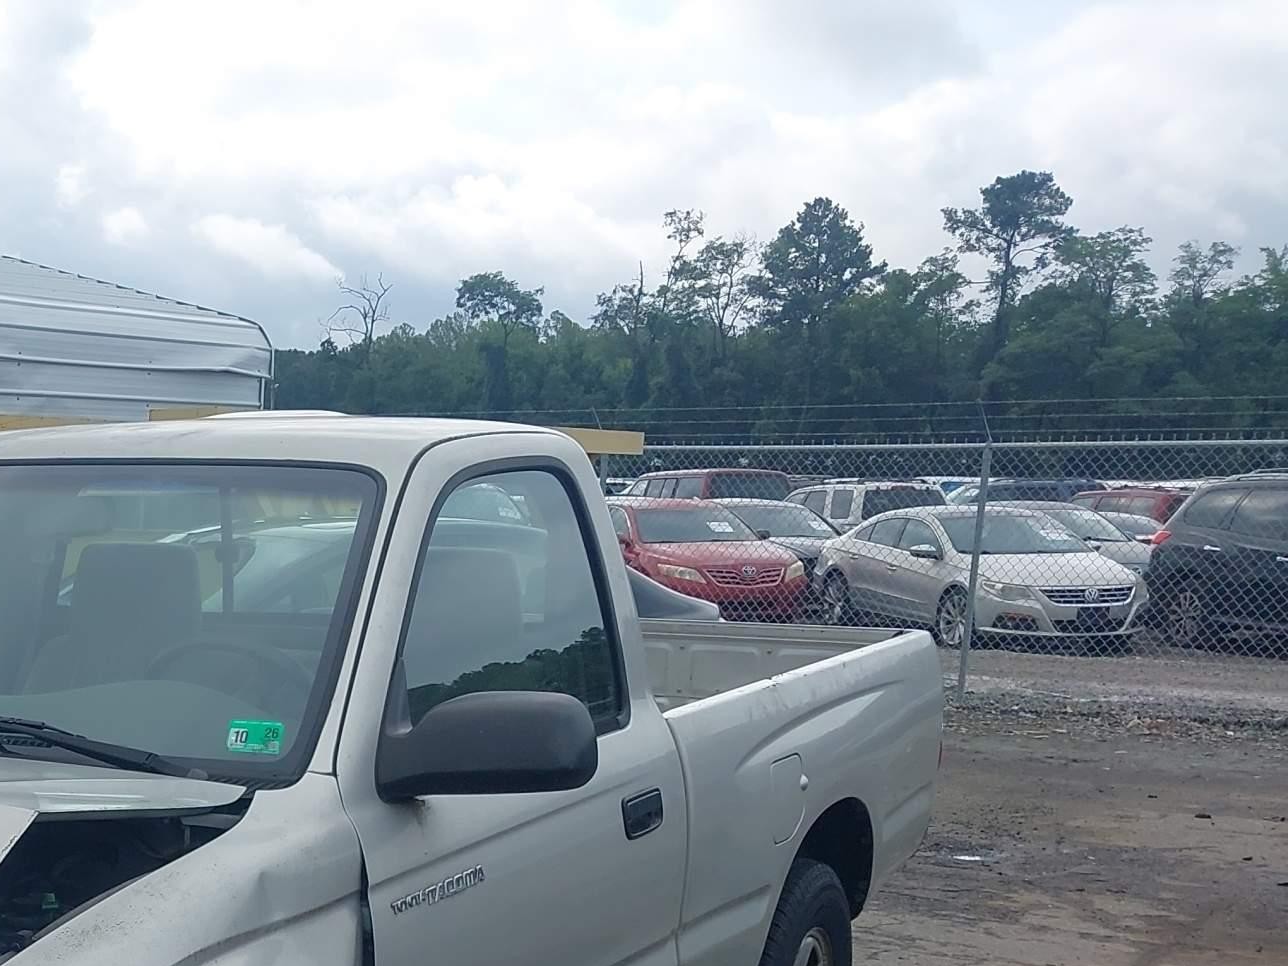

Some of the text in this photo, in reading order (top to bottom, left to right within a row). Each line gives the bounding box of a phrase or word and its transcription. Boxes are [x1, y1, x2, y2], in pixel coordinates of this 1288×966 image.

[233, 727, 280, 744] 10 26
[424, 864, 486, 905] TACOMA
